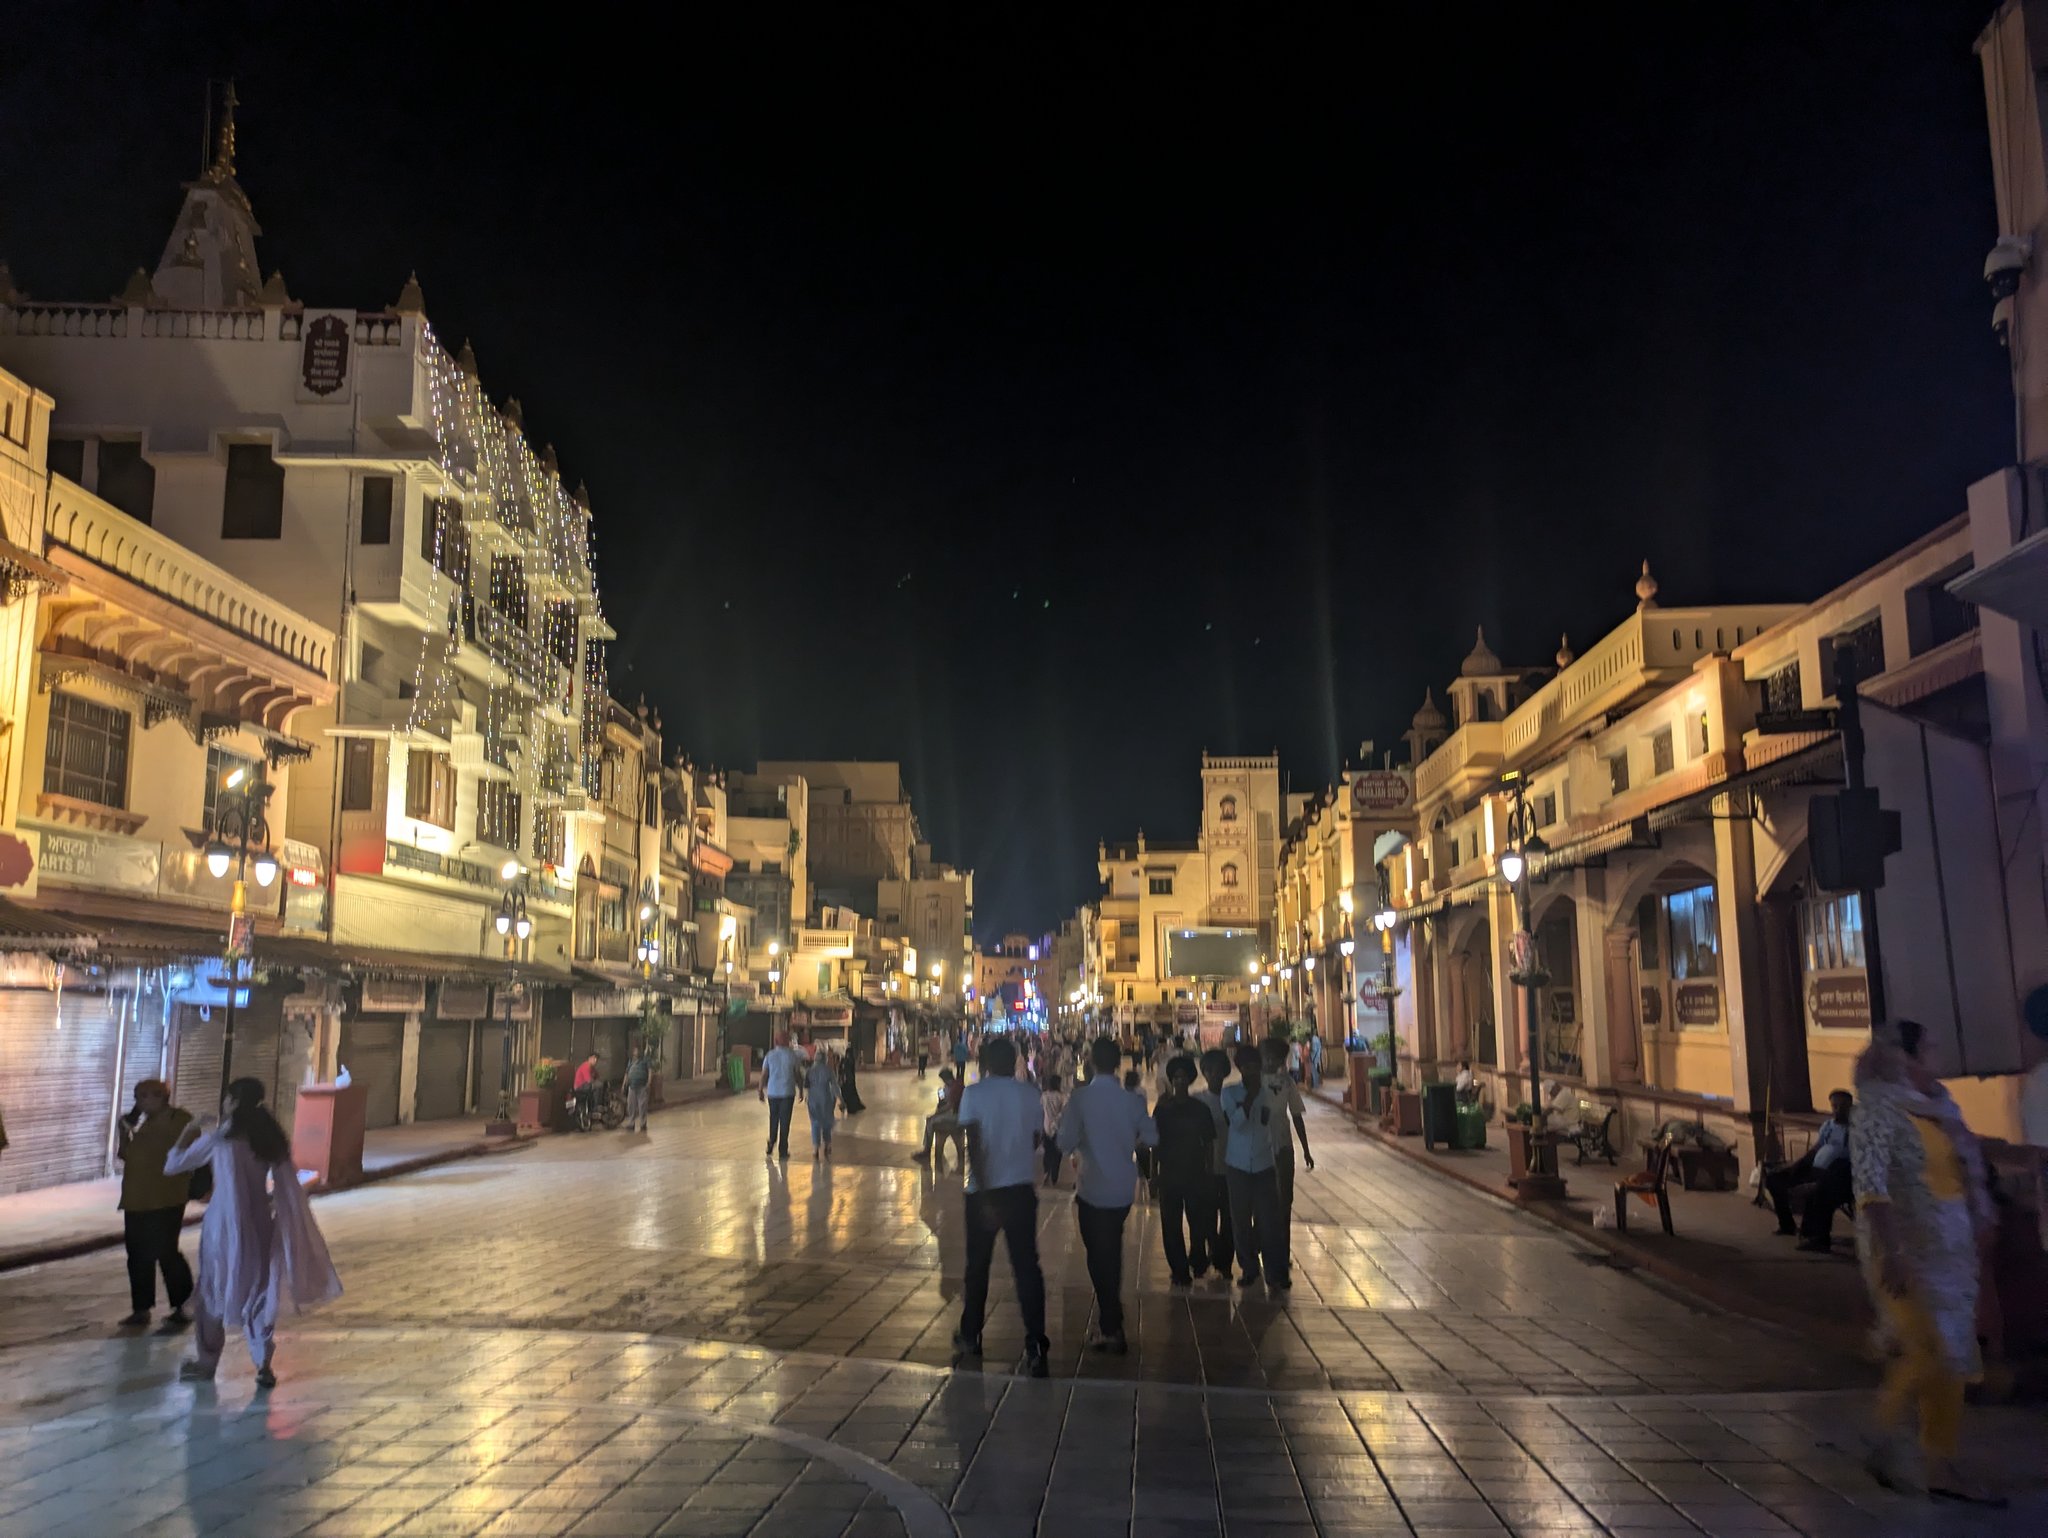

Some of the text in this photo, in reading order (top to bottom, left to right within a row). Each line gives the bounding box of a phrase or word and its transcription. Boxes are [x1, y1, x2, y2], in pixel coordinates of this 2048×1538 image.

[1356, 787, 1406, 799] MAHAJAN STORE
[39, 852, 74, 872] ARTS
